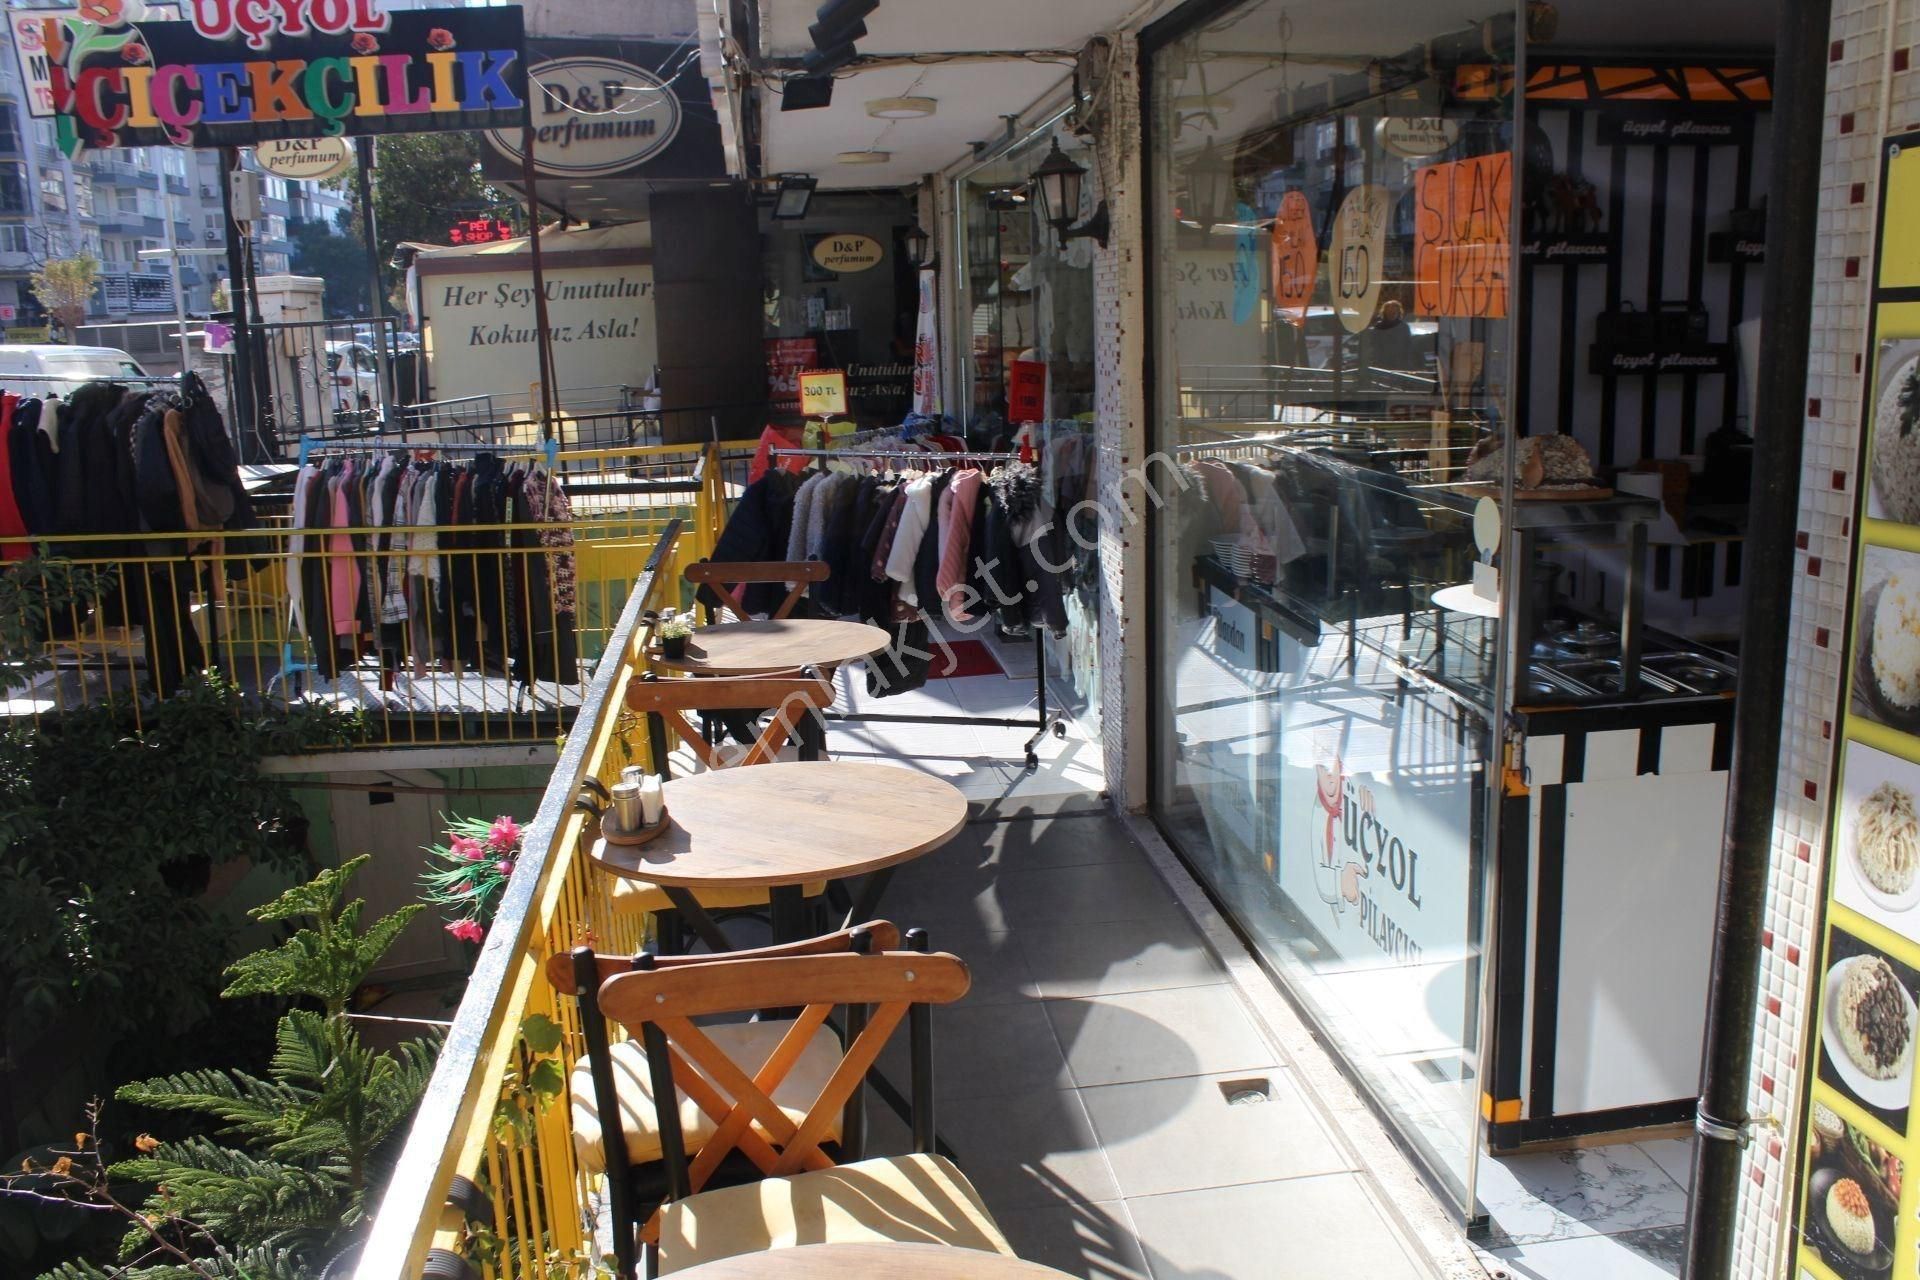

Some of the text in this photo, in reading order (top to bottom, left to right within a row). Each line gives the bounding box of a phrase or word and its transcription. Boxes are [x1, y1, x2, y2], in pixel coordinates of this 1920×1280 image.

[542, 80, 626, 115] D&P
[269, 152, 340, 168] perfumum
[1421, 157, 1507, 243] SICAK
[469, 220, 489, 231] PET
[465, 231, 494, 241] SHOP
[832, 240, 864, 253] D&P
[823, 254, 875, 266] perfumum
[1338, 244, 1370, 299] 150
[1417, 236, 1507, 317] ÇORBA
[443, 285, 488, 307] Her
[494, 283, 535, 309] Şey
[577, 317, 639, 341] Asla!
[804, 386, 823, 396] 300
[826, 387, 837, 396] TL
